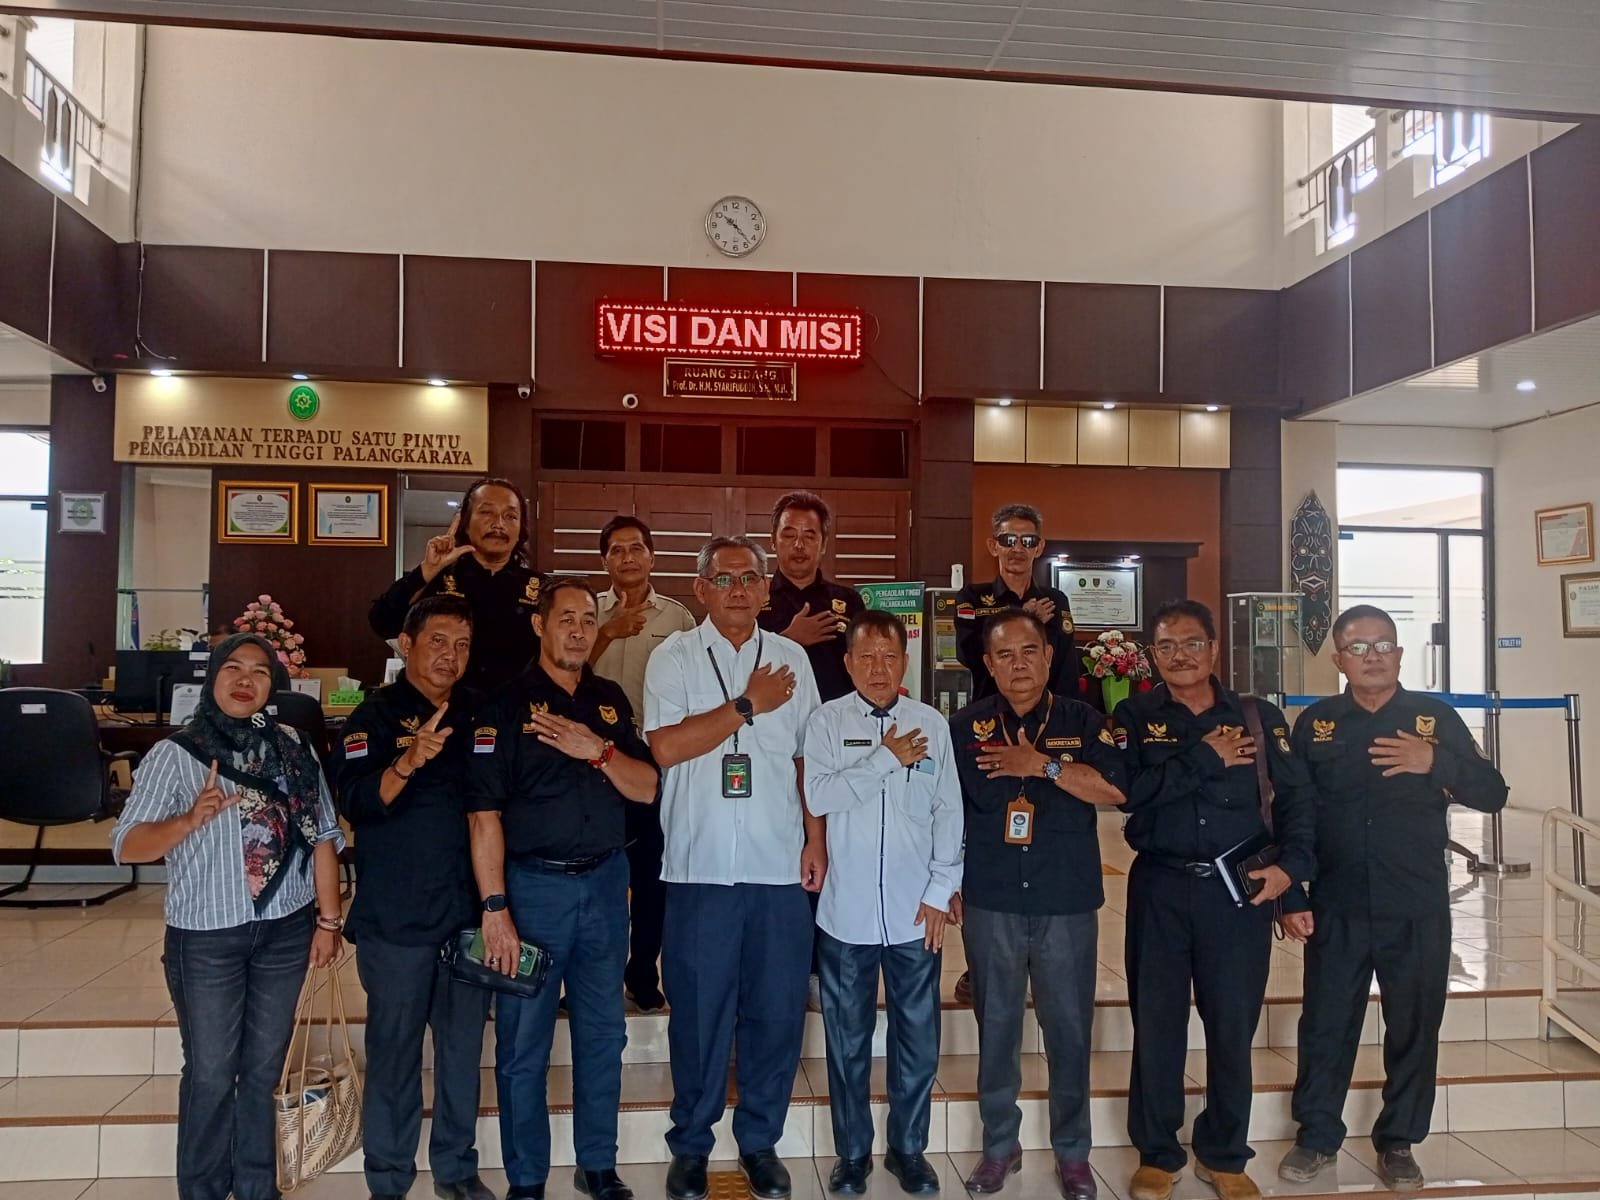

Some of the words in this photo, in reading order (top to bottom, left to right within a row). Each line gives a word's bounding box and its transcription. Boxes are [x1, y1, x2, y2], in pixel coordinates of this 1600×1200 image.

[606, 312, 677, 344] VISI
[691, 316, 768, 348] DAN
[780, 320, 852, 351] MISI
[684, 368, 726, 379] RUANG
[672, 380, 688, 391] Prof.
[688, 381, 698, 391] Dr.
[699, 381, 713, 391] H.M.
[143, 425, 253, 442] PELAYANAN
[260, 428, 342, 444] TERPADU
[351, 431, 396, 447] SATU
[402, 433, 461, 449] PINTU
[128, 441, 245, 458] PENGADILAN
[252, 444, 323, 460] TINGGI
[333, 446, 473, 465] PALANGKARAYA
[895, 614, 918, 624] ODEL
